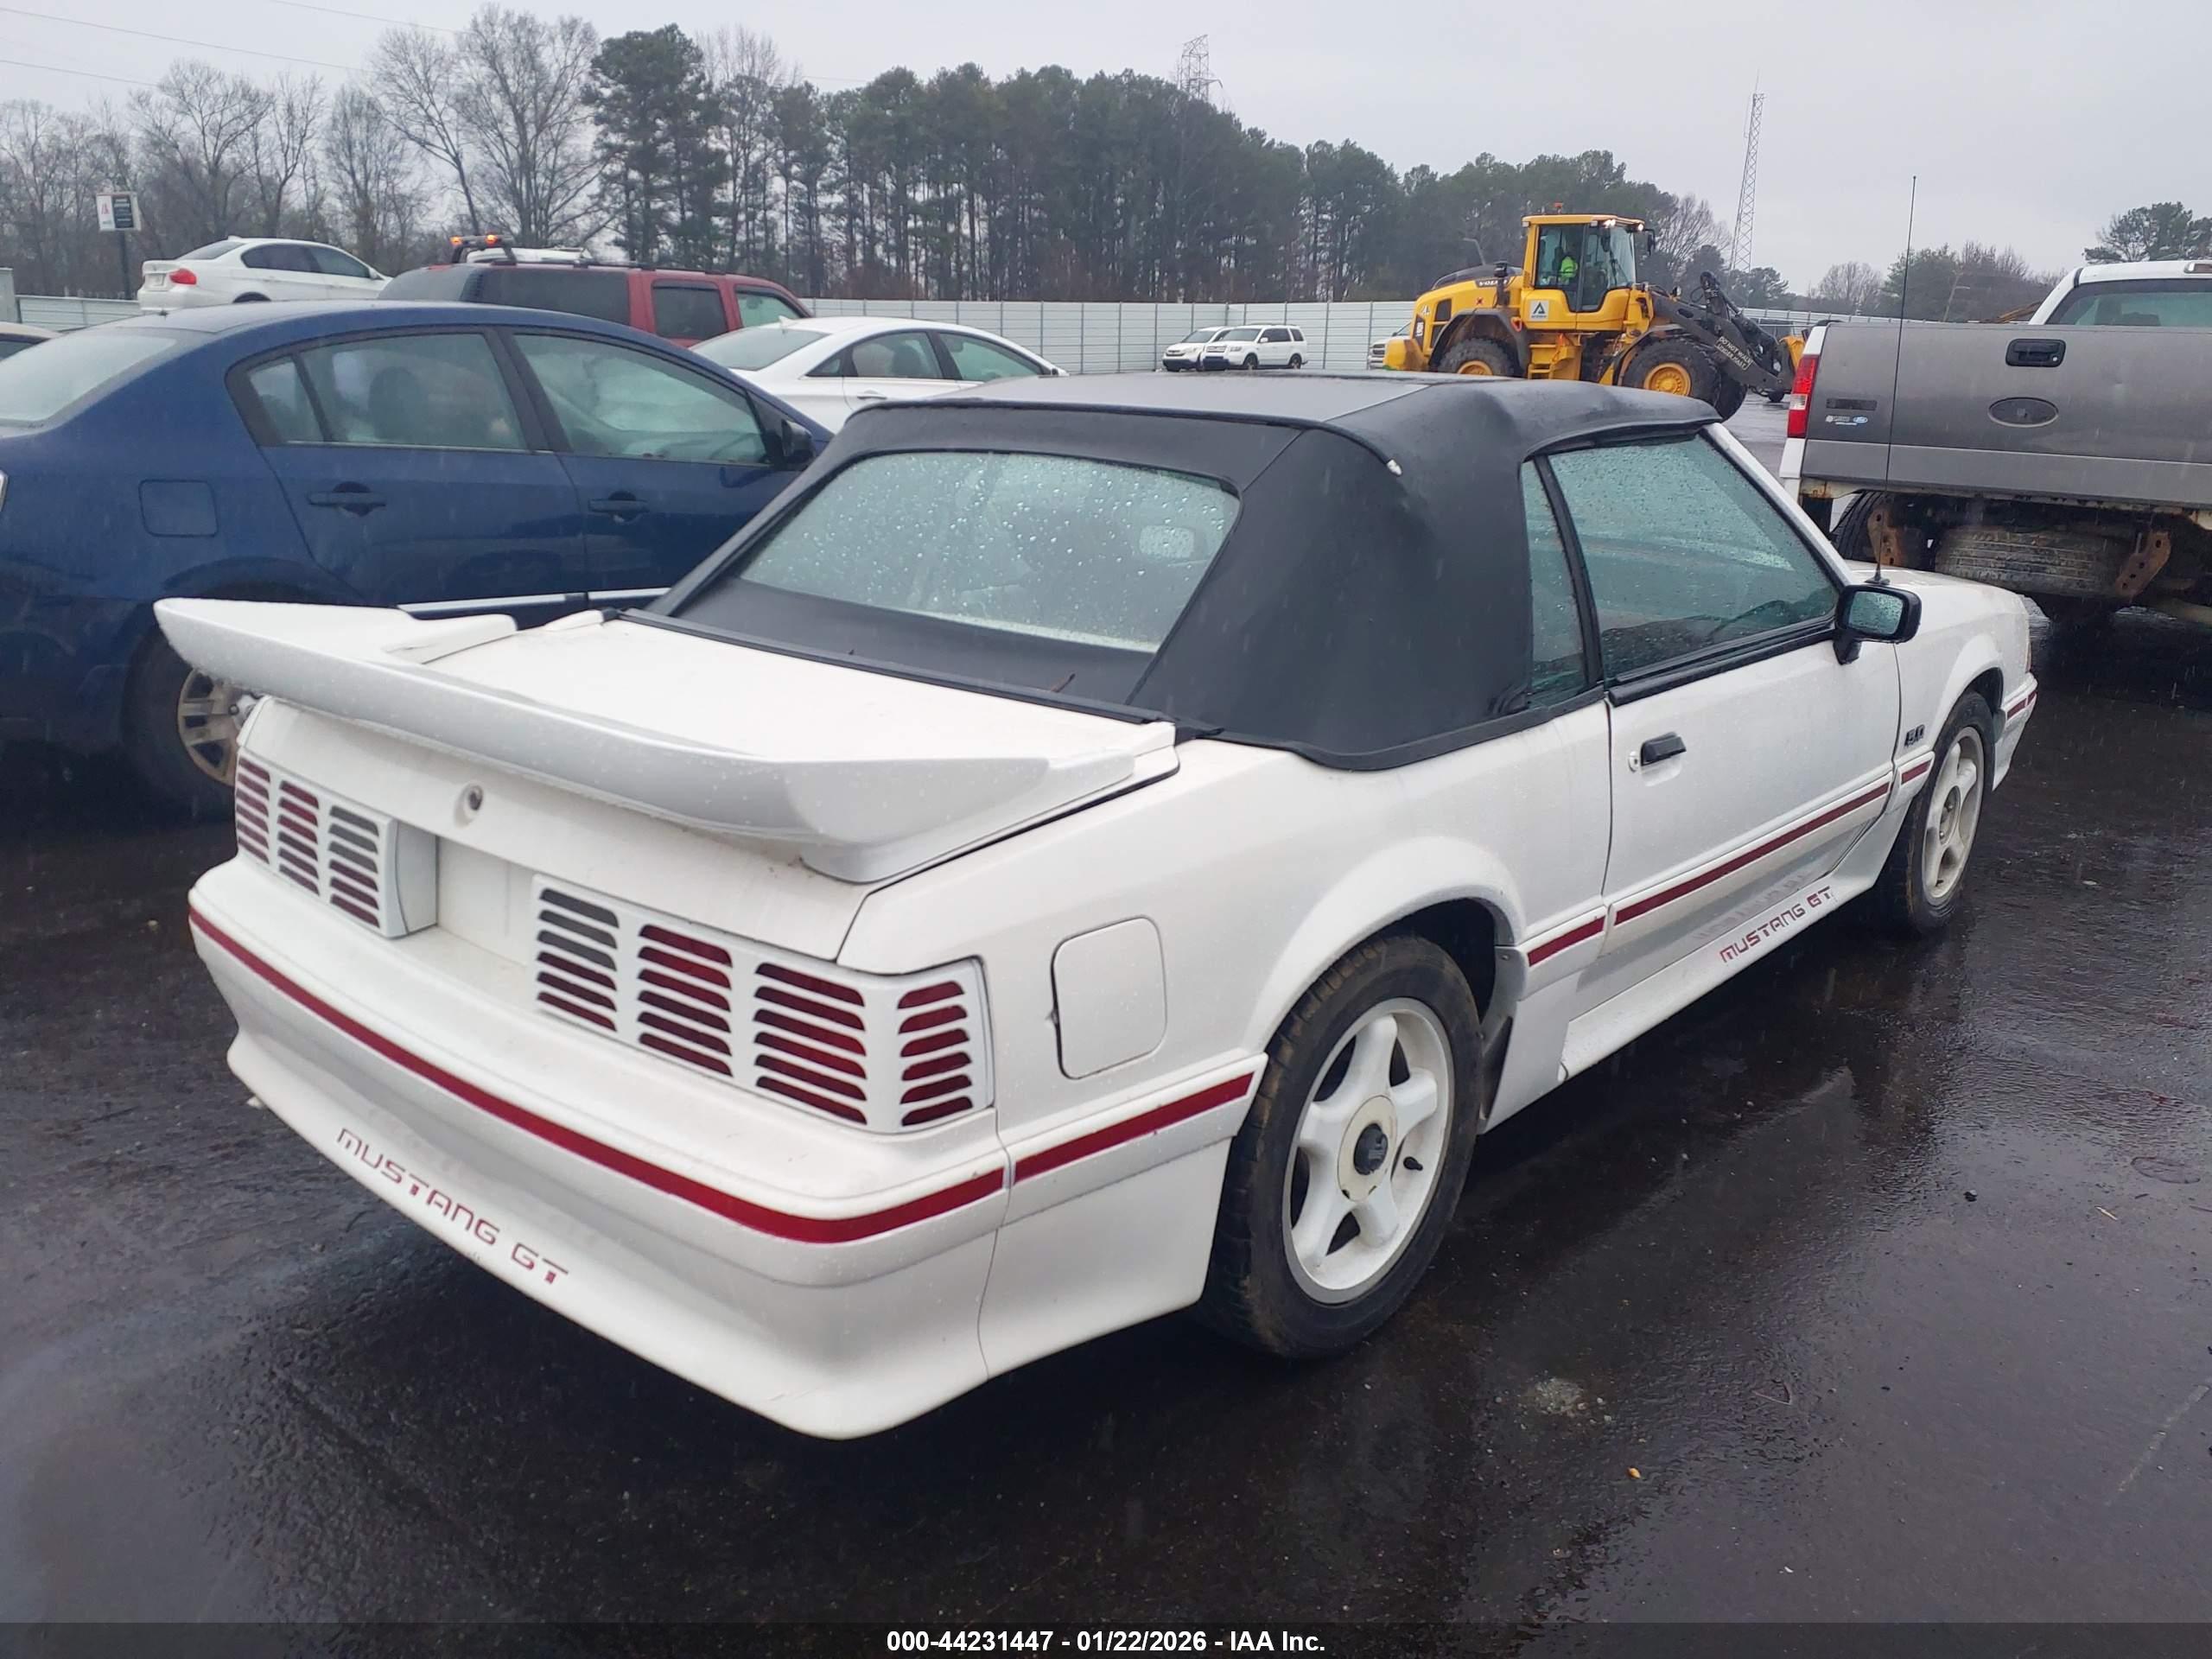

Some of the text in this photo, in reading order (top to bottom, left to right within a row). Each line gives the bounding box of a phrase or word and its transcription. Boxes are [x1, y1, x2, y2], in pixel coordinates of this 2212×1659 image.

[1719, 886, 1830, 963] MUSTANG GT
[336, 1128, 569, 1285] MUSTANG GT
